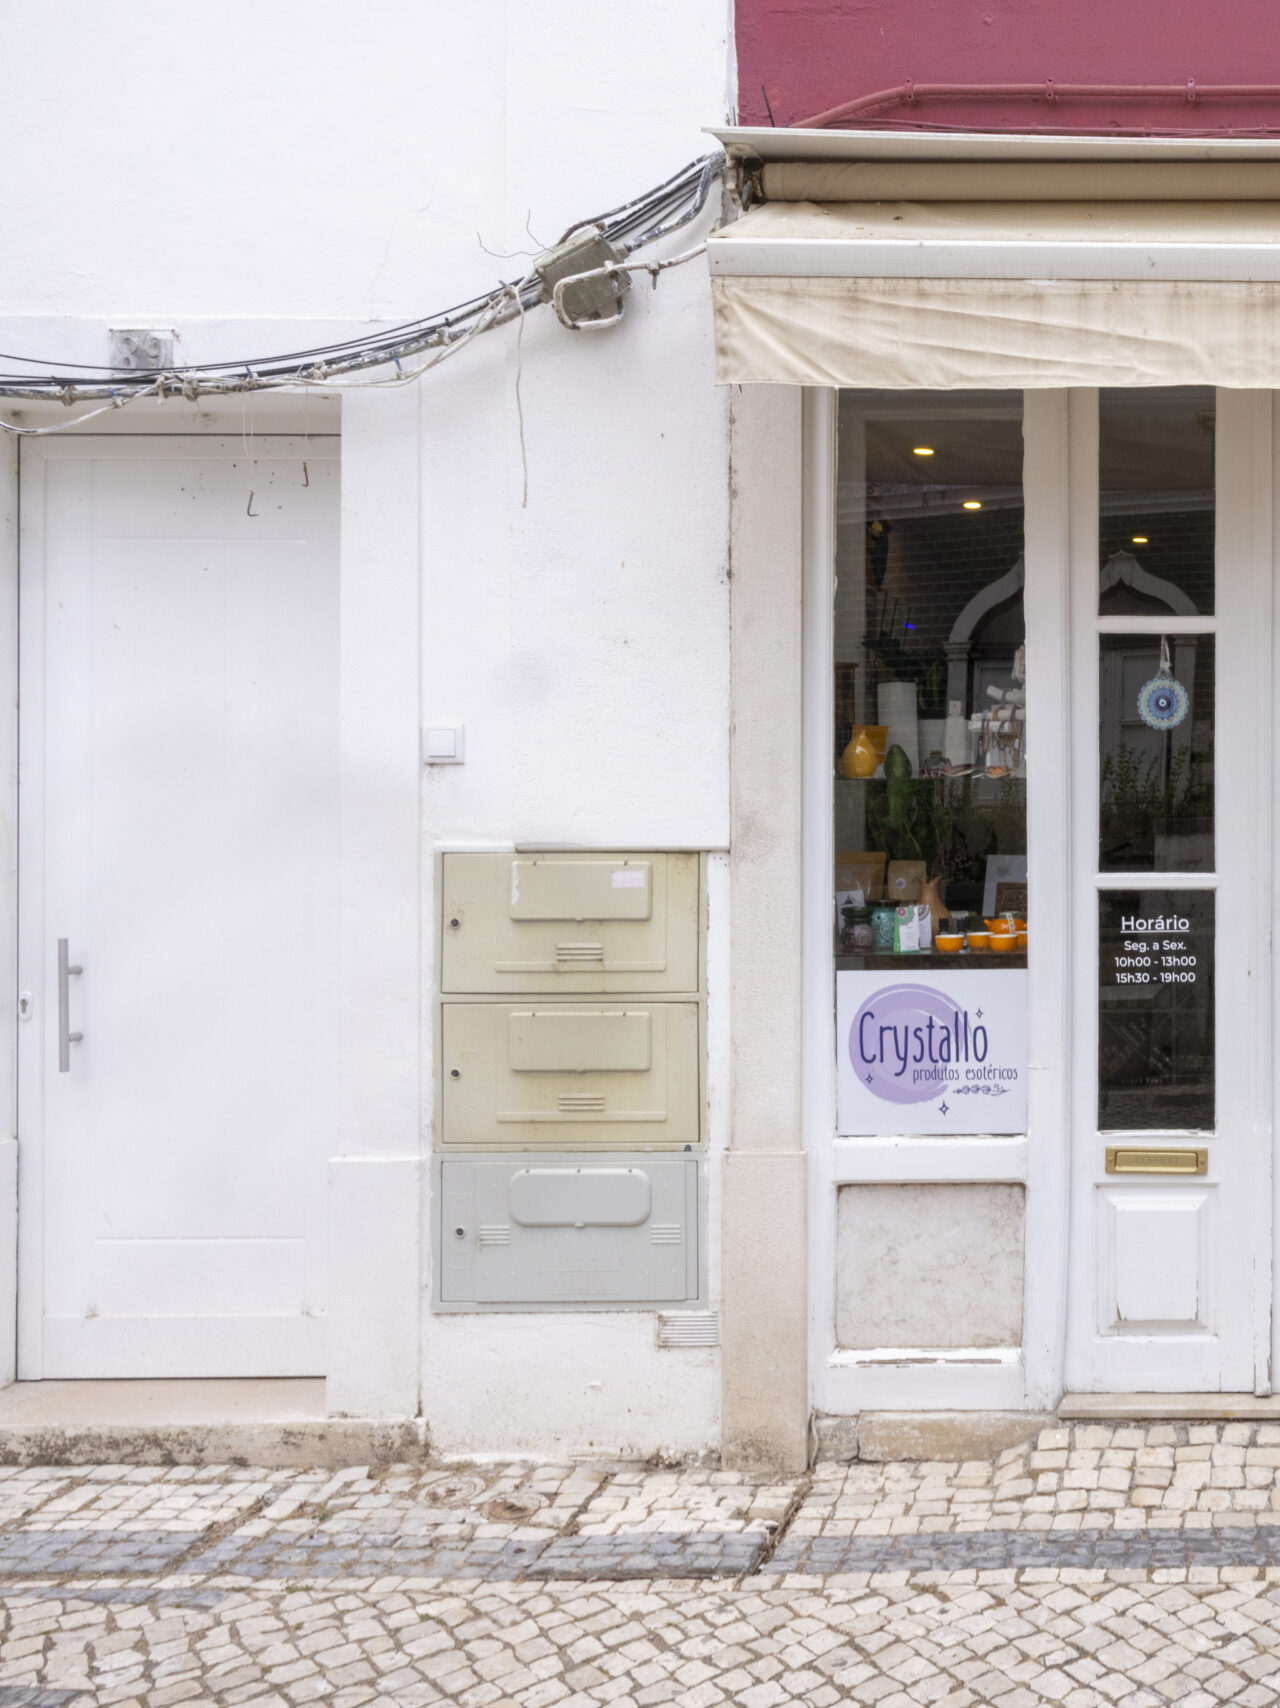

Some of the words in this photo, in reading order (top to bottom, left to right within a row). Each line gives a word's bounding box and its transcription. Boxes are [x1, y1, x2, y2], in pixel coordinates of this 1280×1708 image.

[1121, 915, 1190, 931] Horário
[1124, 940, 1150, 953] Seg.
[1152, 942, 1160, 951] a
[1162, 940, 1187, 951] Sex.
[1114, 956, 1151, 967] 10h00
[1160, 956, 1197, 967] 13h00
[1115, 973, 1150, 983] 15h30
[1160, 972, 1196, 983] 19h00
[859, 1010, 989, 1077] Crystallo
[913, 1065, 960, 1084] produtos
[965, 1064, 1018, 1081] esotéricos
